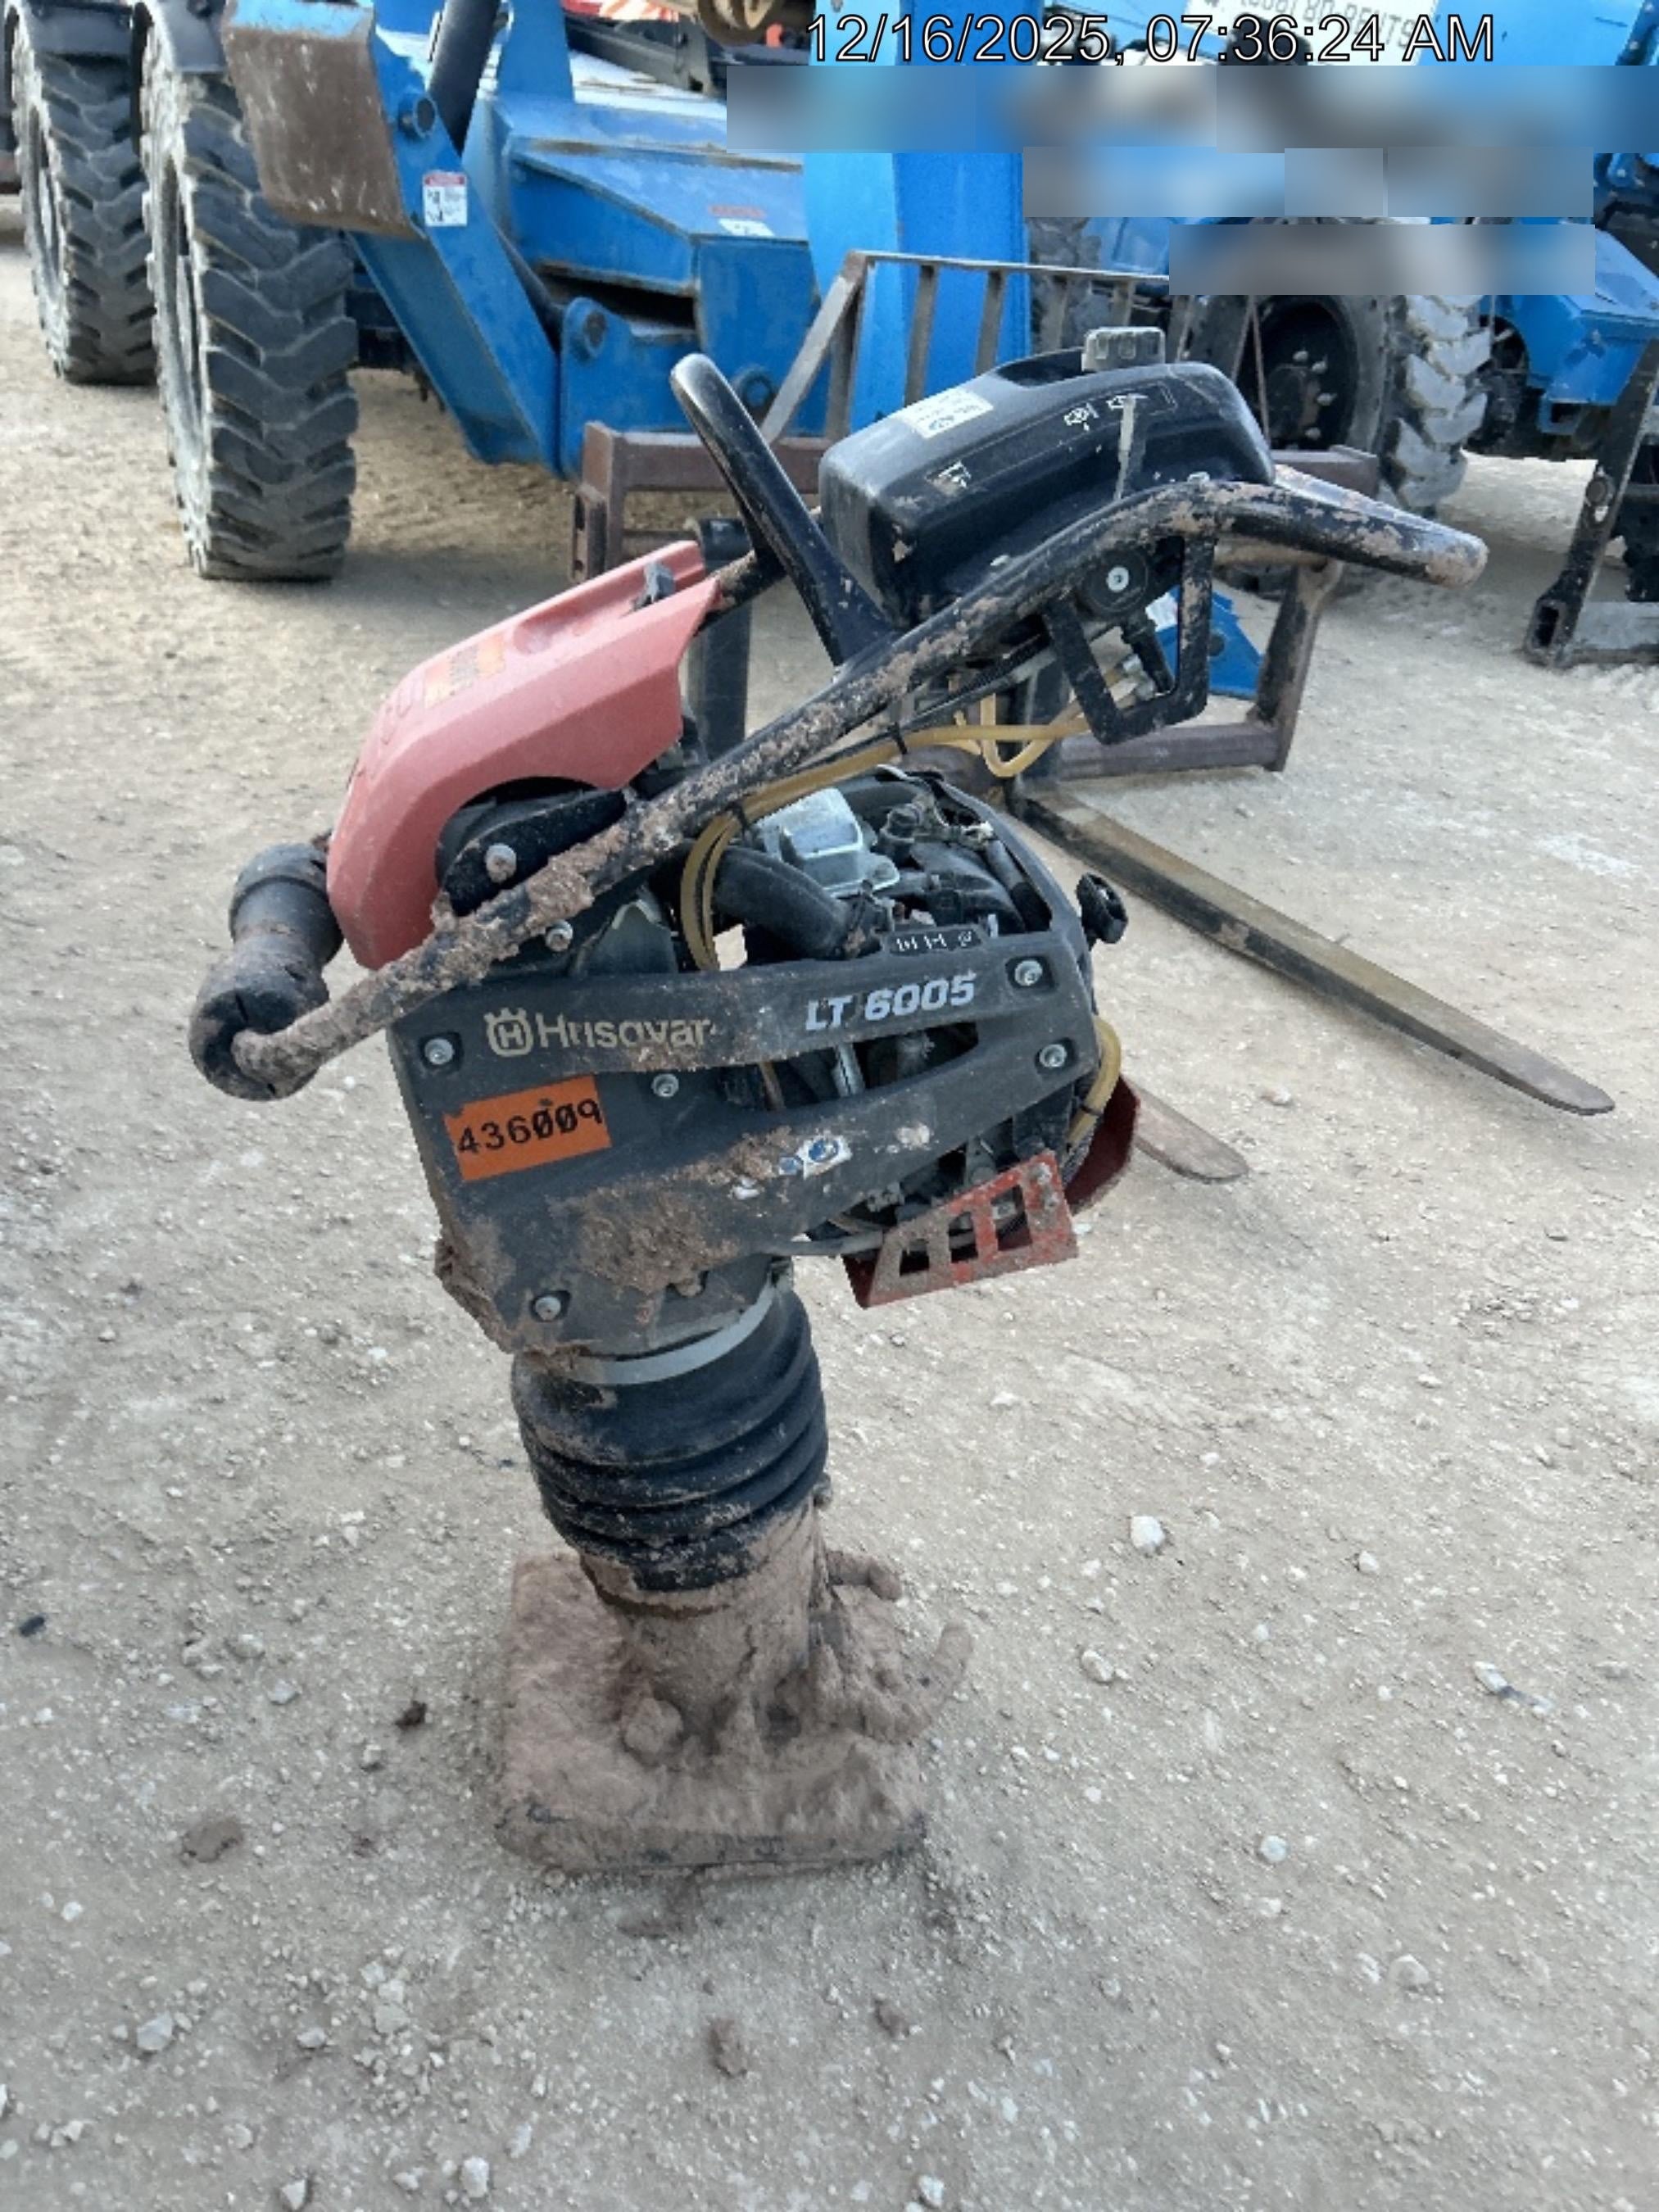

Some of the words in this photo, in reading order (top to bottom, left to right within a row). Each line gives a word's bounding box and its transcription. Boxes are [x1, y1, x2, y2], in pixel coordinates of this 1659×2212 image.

[805, 995, 854, 1031] LT
[863, 971, 977, 1021] 6005
[459, 1099, 603, 1154] 436009
